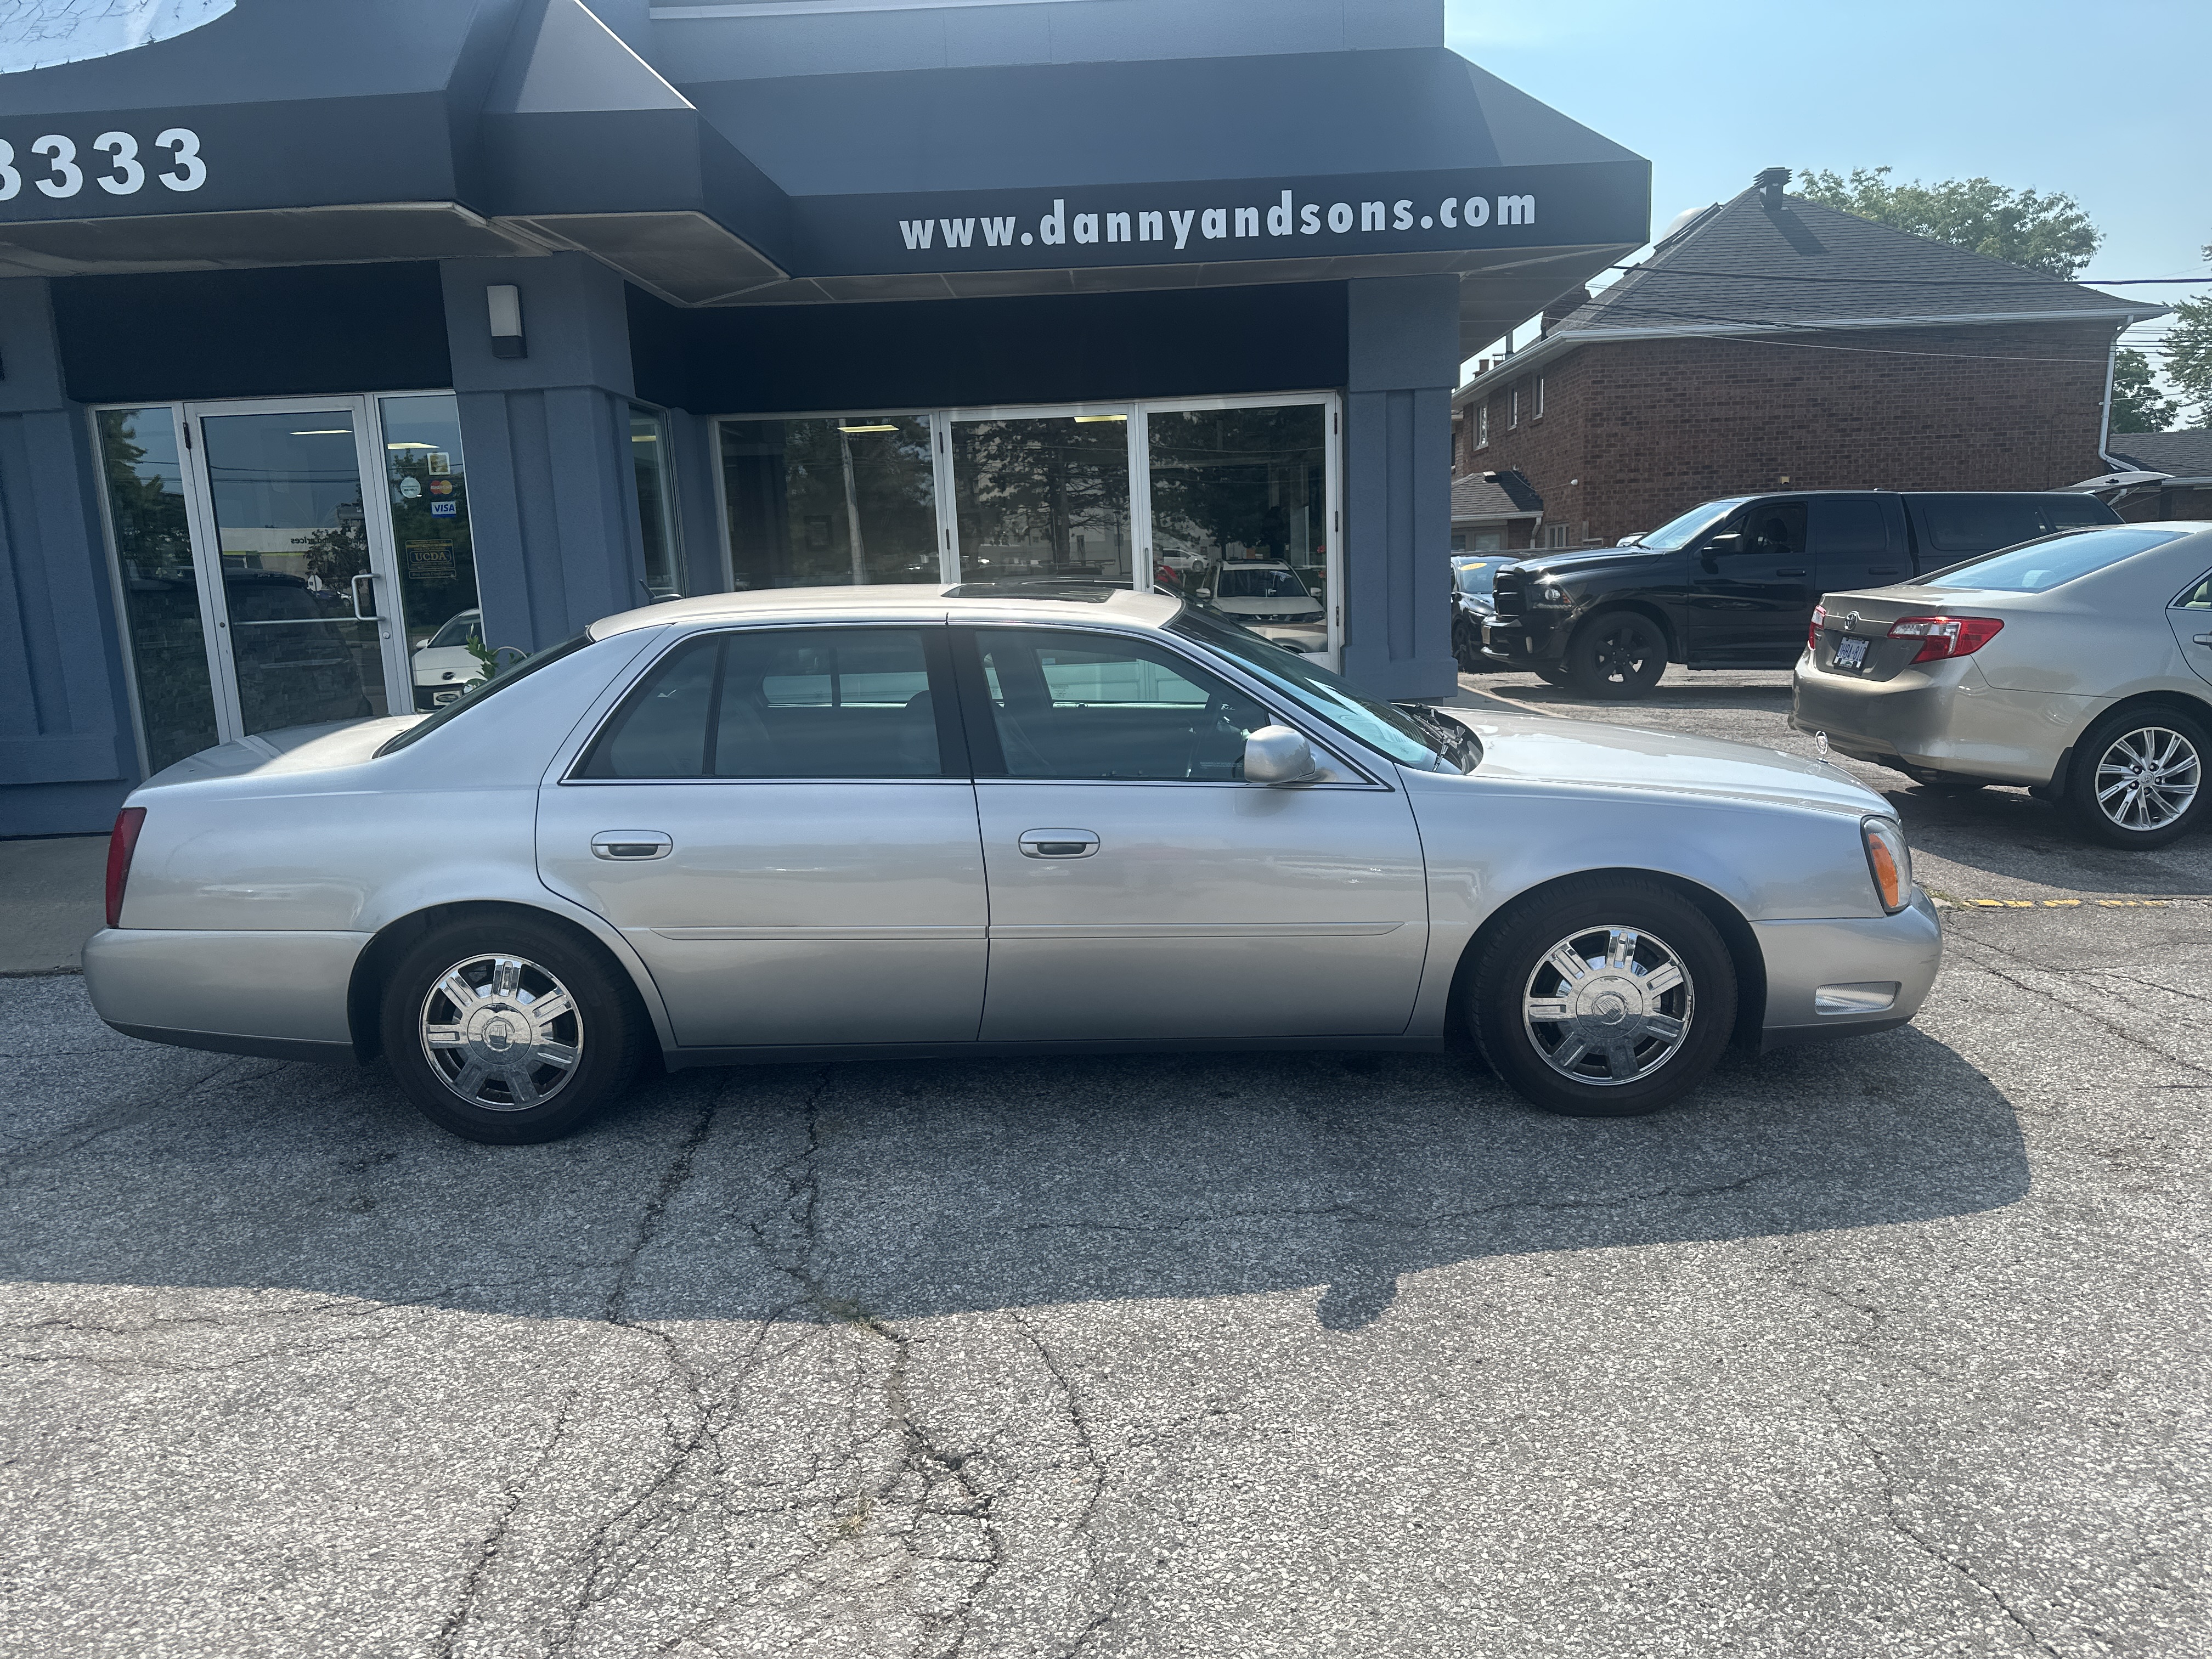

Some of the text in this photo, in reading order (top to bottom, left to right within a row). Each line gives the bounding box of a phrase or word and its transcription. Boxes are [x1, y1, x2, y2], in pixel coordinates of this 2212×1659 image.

[899, 190, 1535, 249] www.dannyandsons.com
[434, 504, 455, 512] VISA
[415, 551, 448, 561] UCDA
